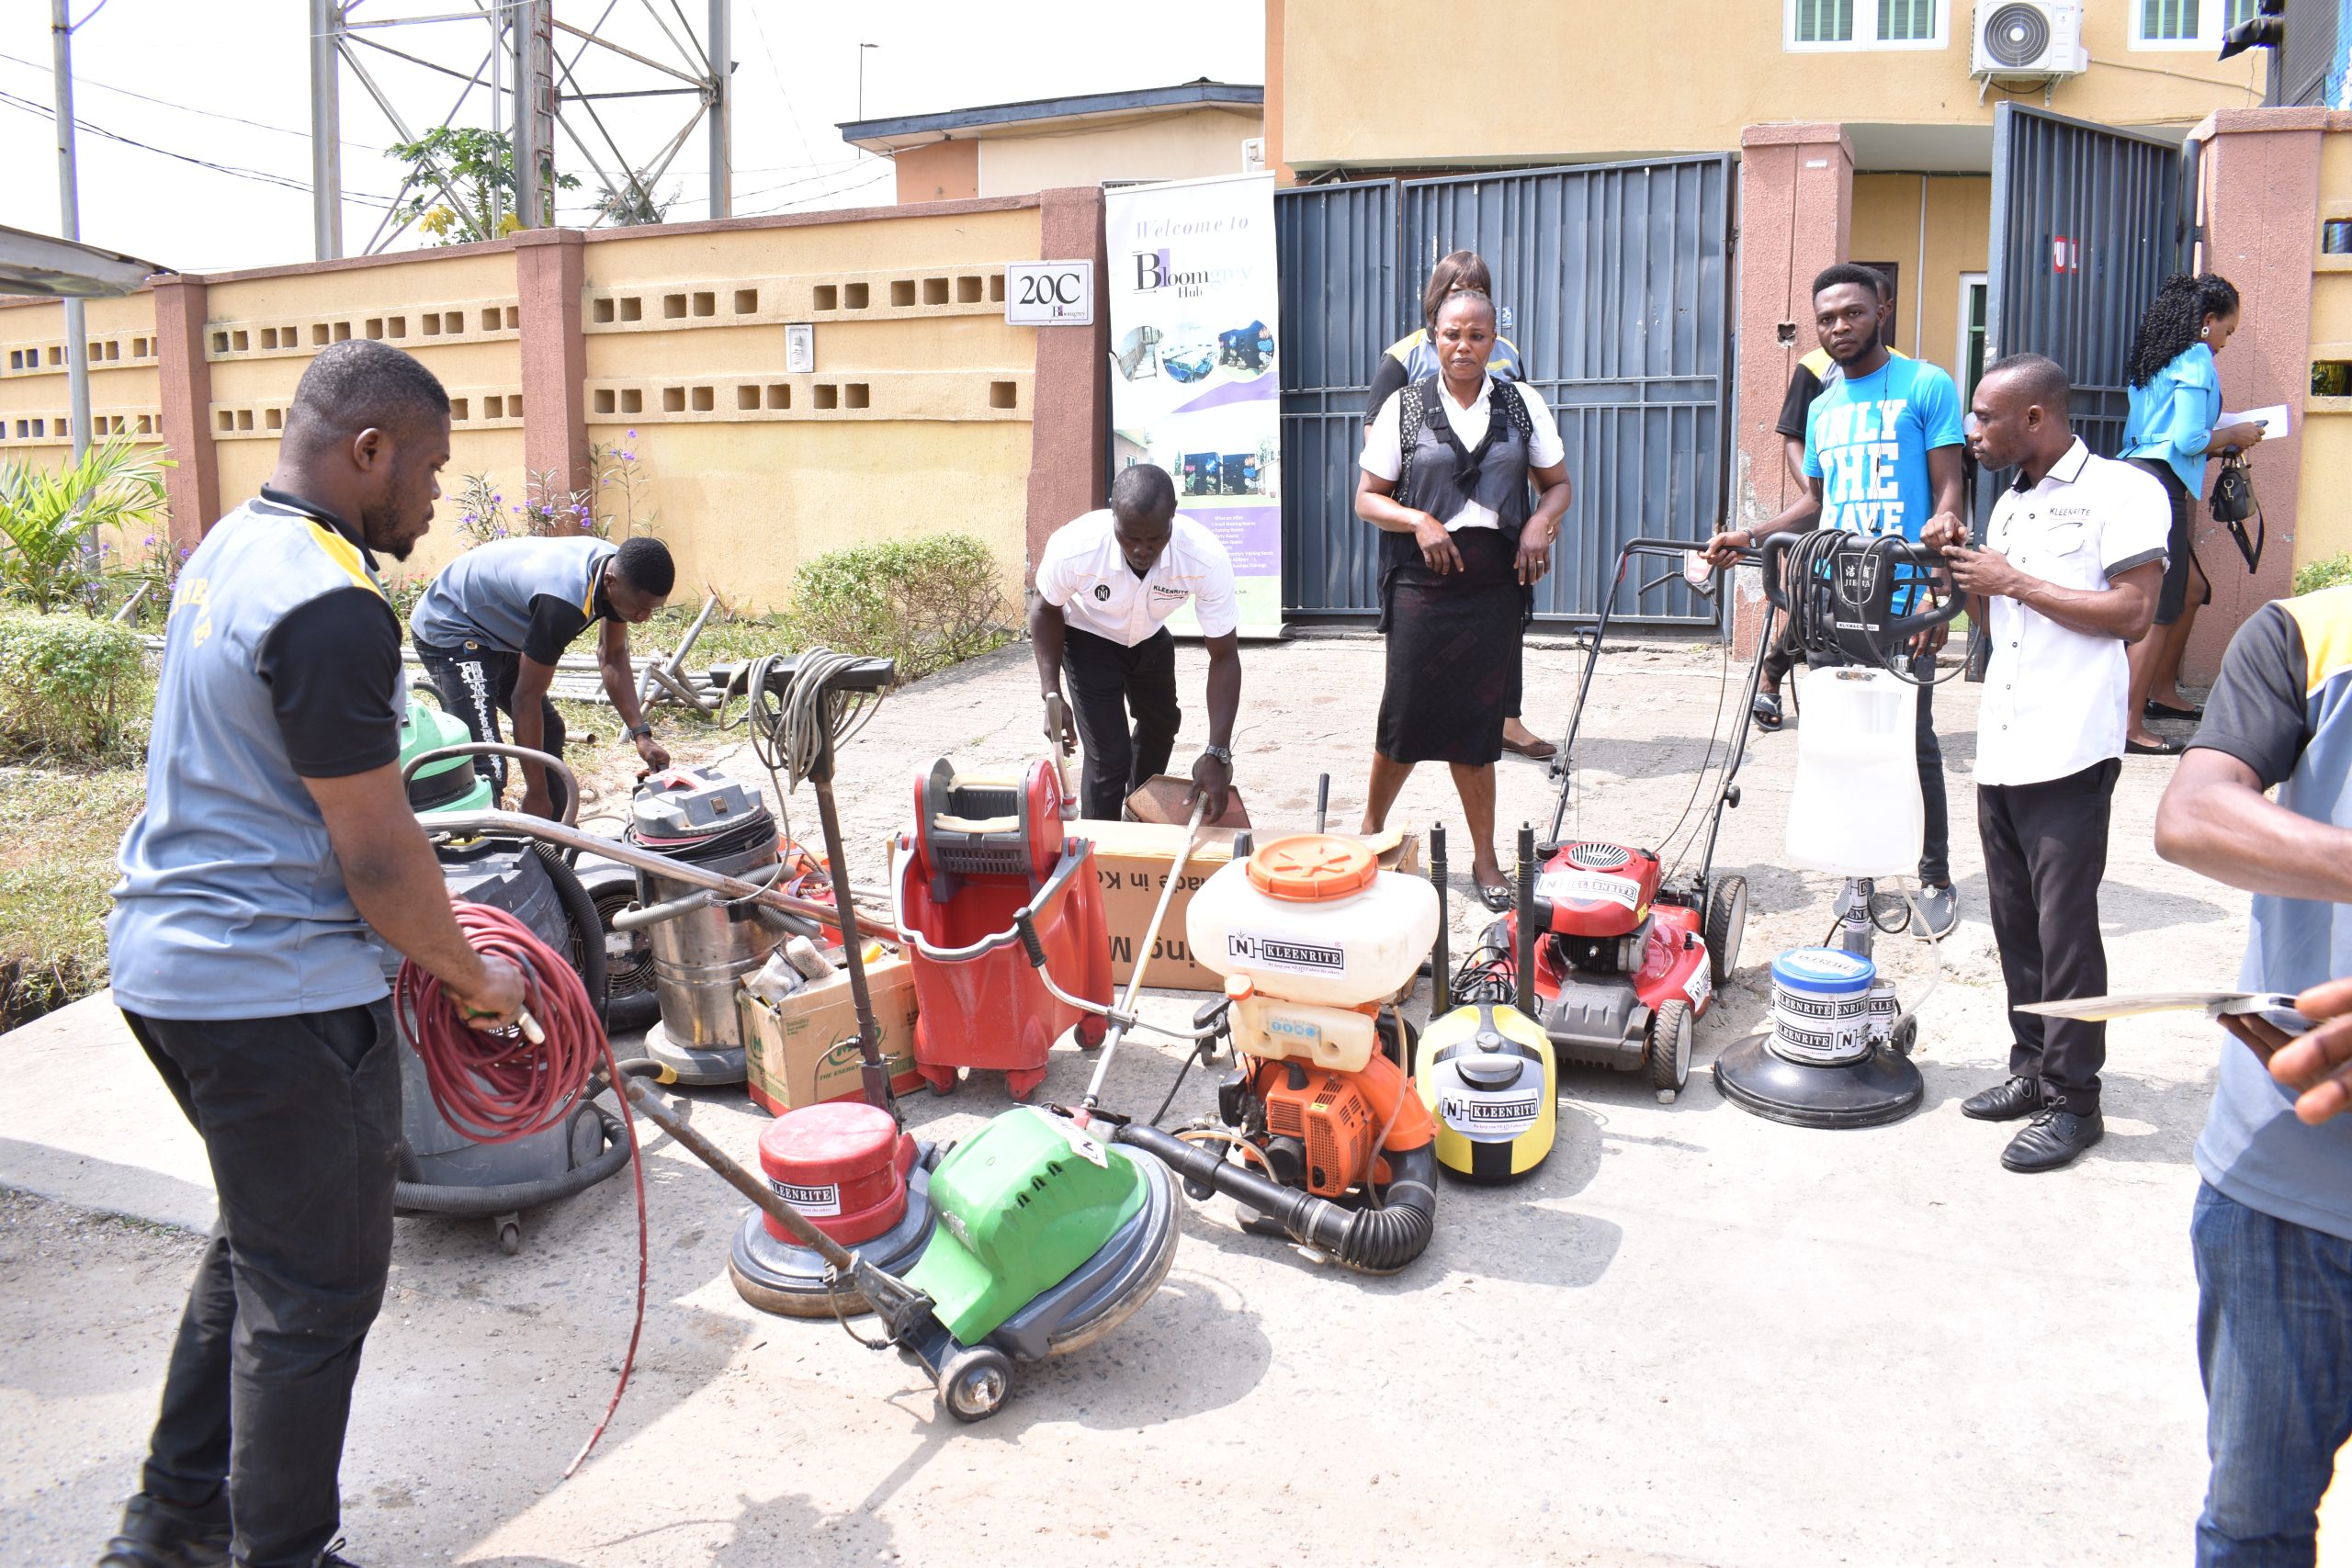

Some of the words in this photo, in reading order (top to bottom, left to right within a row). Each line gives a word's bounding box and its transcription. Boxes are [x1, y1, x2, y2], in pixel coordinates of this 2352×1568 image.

[1136, 219, 1223, 239] Welcome
[1230, 216, 1249, 230] to
[1019, 273, 1080, 304] 20C
[1178, 286, 1203, 299] Hub
[1815, 399, 1907, 452] ONLY
[1818, 442, 1899, 502] THE
[1818, 502, 1905, 536] RAVE
[2049, 506, 2091, 516] KLEENRITE
[1153, 585, 1189, 594] KLEENRITE
[1131, 873, 1149, 892] in
[1159, 874, 1204, 893] ade
[1267, 945, 1340, 964] KLEENRITE
[1871, 1000, 1893, 1011] KLE
[820, 1072, 832, 1081] THE
[834, 1065, 859, 1077] ENERGY
[1474, 1104, 1535, 1118] KLEENRITE
[769, 1180, 831, 1201] KLEENRITE
